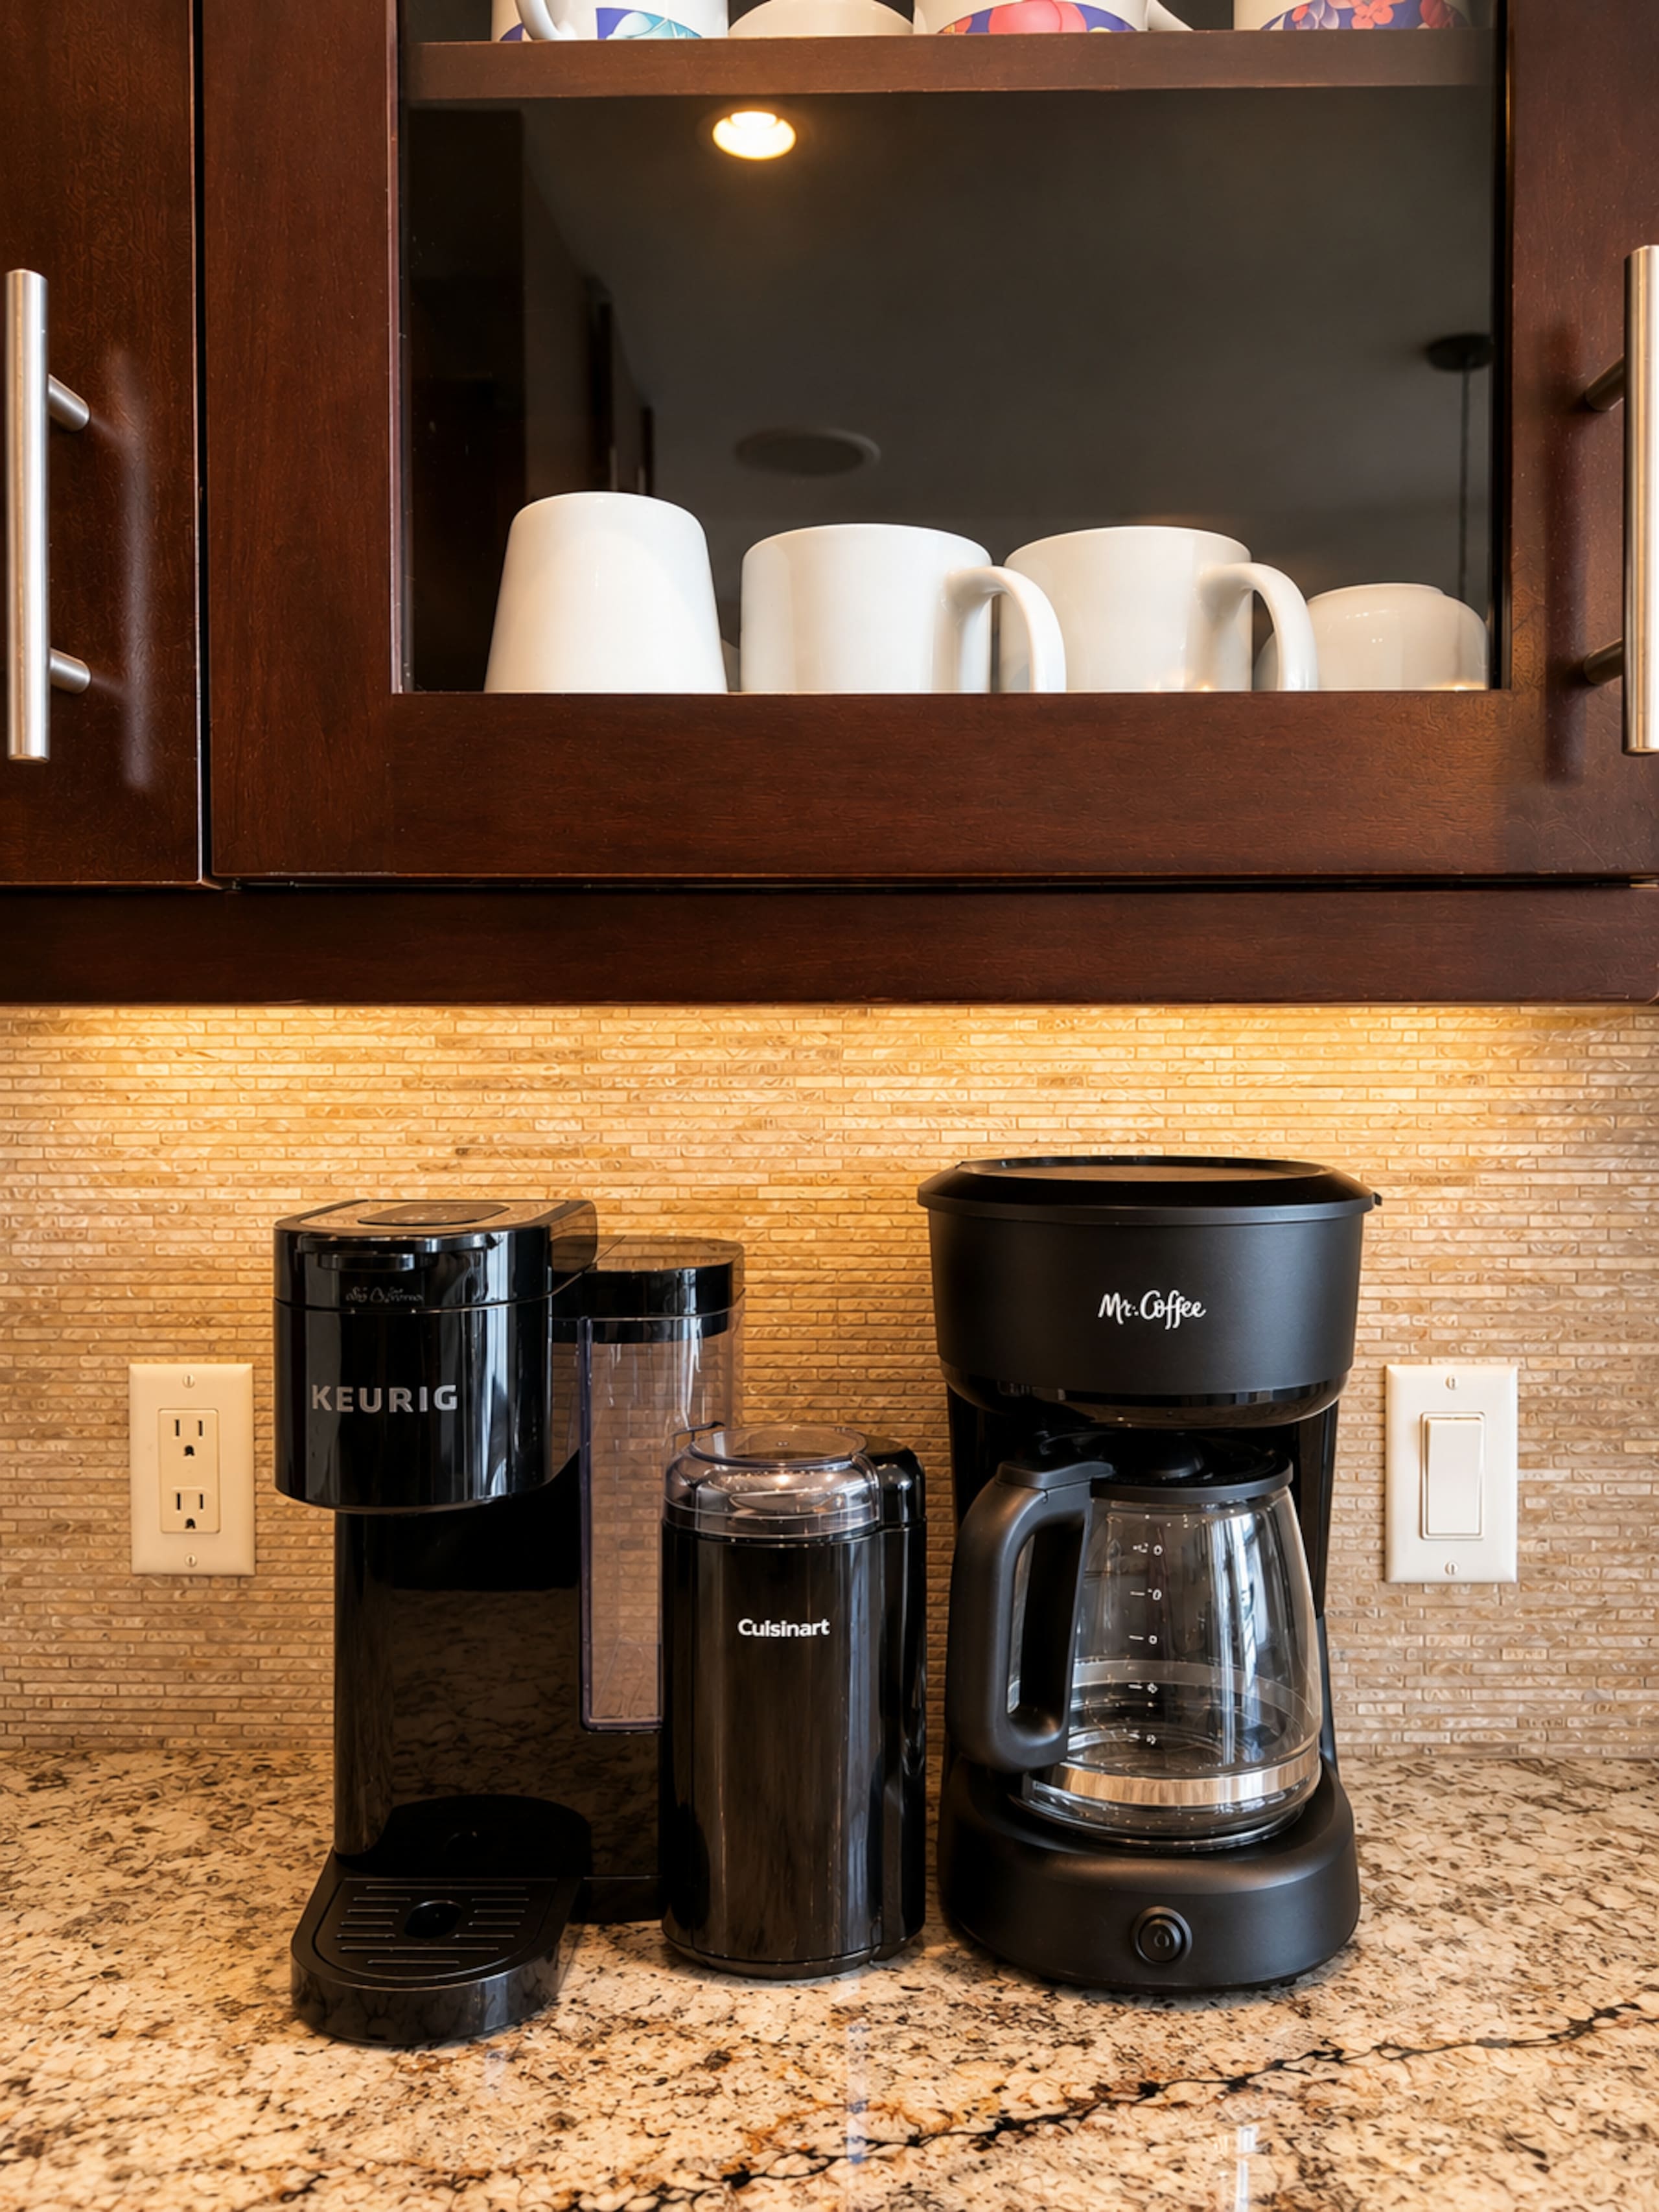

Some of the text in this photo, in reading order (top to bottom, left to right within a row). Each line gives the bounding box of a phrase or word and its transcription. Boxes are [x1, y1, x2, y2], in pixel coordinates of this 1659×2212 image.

[1098, 1290, 1206, 1330] Mr. Coffee
[312, 1384, 458, 1413] KEURIG
[737, 1618, 830, 1637] Cuisinart
